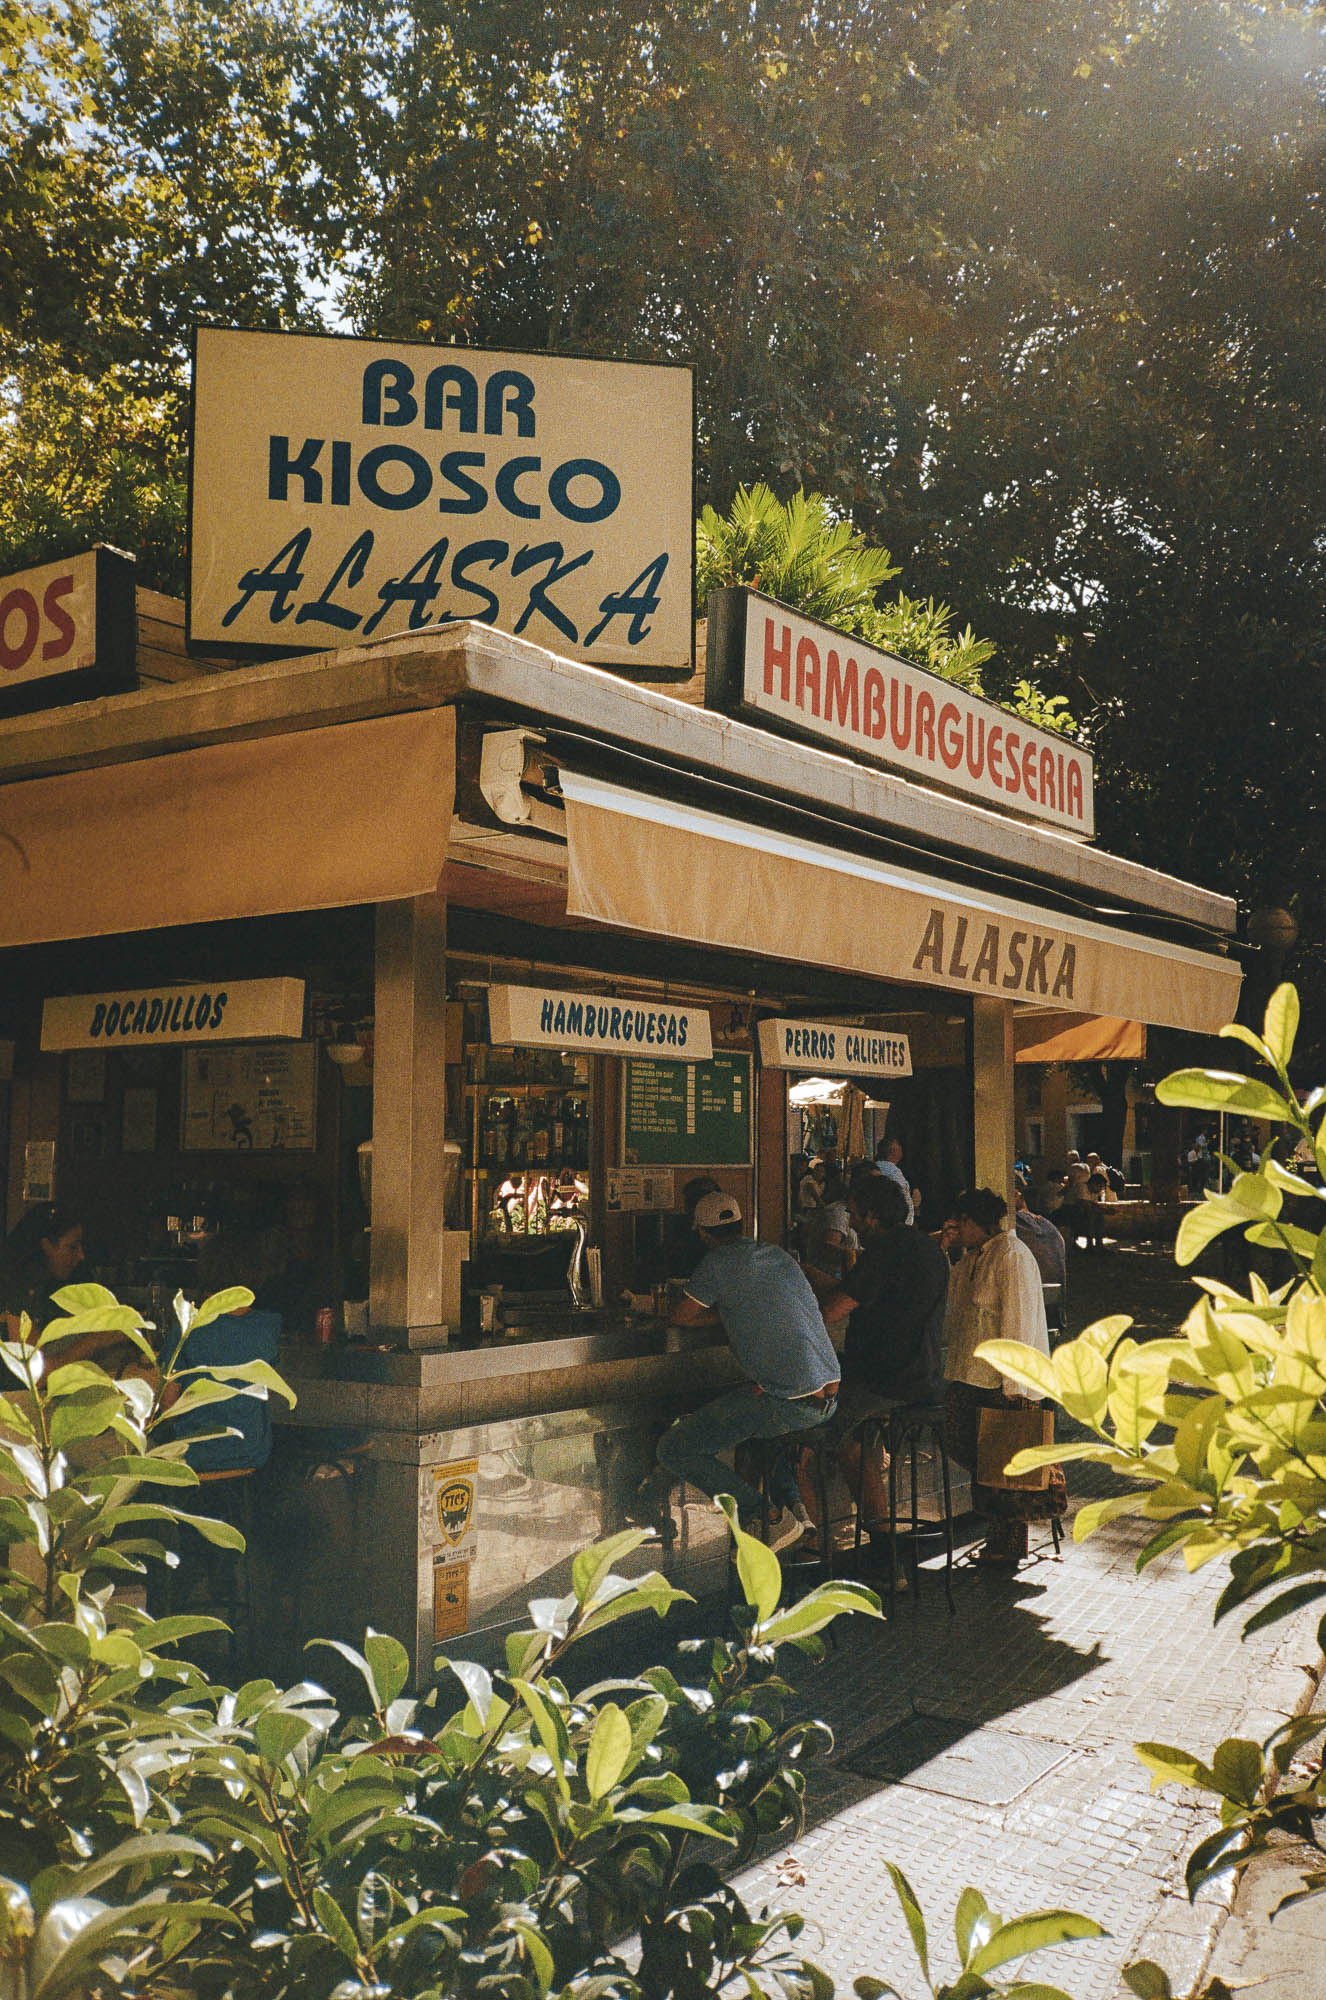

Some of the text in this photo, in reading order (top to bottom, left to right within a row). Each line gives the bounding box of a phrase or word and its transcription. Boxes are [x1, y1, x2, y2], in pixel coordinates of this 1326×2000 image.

[362, 359, 536, 437] BAR
[269, 436, 621, 523] KIOSCO
[222, 528, 668, 646] ALASKA
[764, 619, 1082, 819] HAMBURGUESERIA
[913, 909, 1075, 999] ALASKA
[90, 992, 227, 1037] BOCADILLOS
[541, 999, 688, 1046] HAMBURGUESAS
[785, 1028, 905, 1066] PERROS CALIENTES
